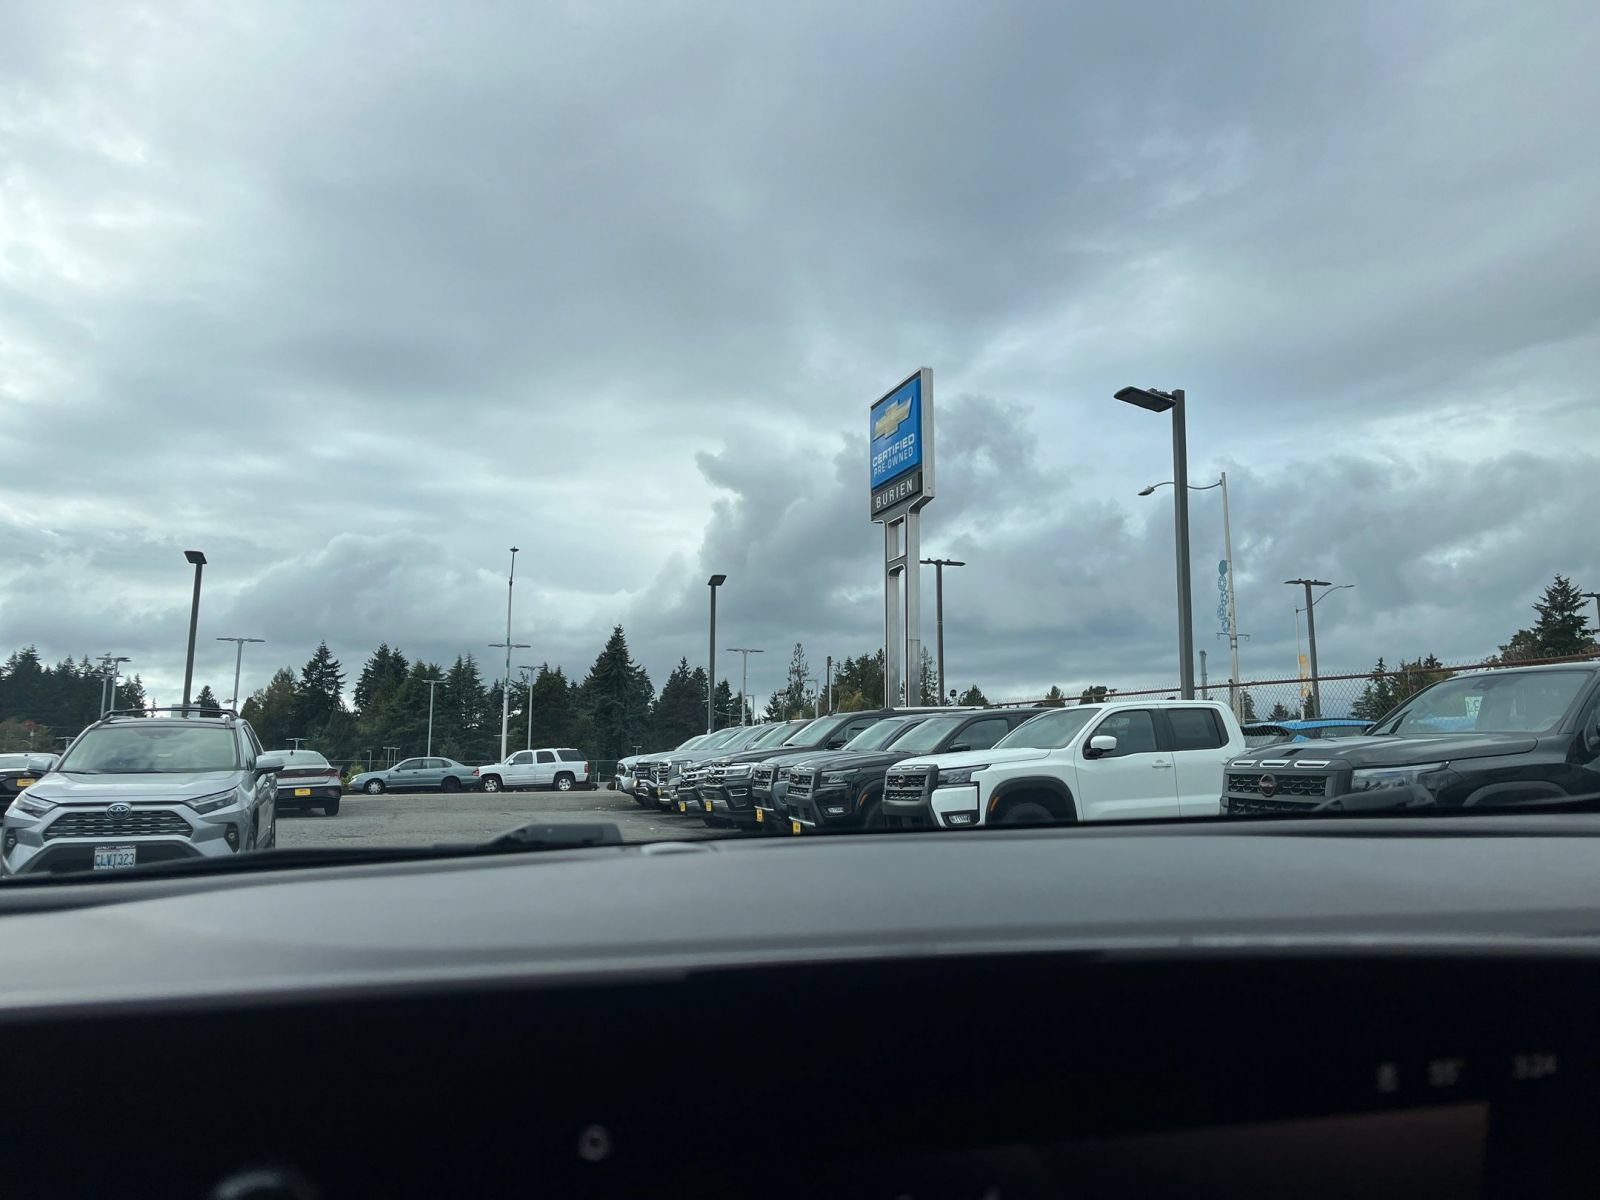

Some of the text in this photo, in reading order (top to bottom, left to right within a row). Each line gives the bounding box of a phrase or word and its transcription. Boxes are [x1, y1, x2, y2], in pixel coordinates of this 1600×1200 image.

[873, 433, 915, 468] CERTIFIED
[873, 446, 914, 478] PRE-OWNED
[876, 479, 913, 508] BURIEN
